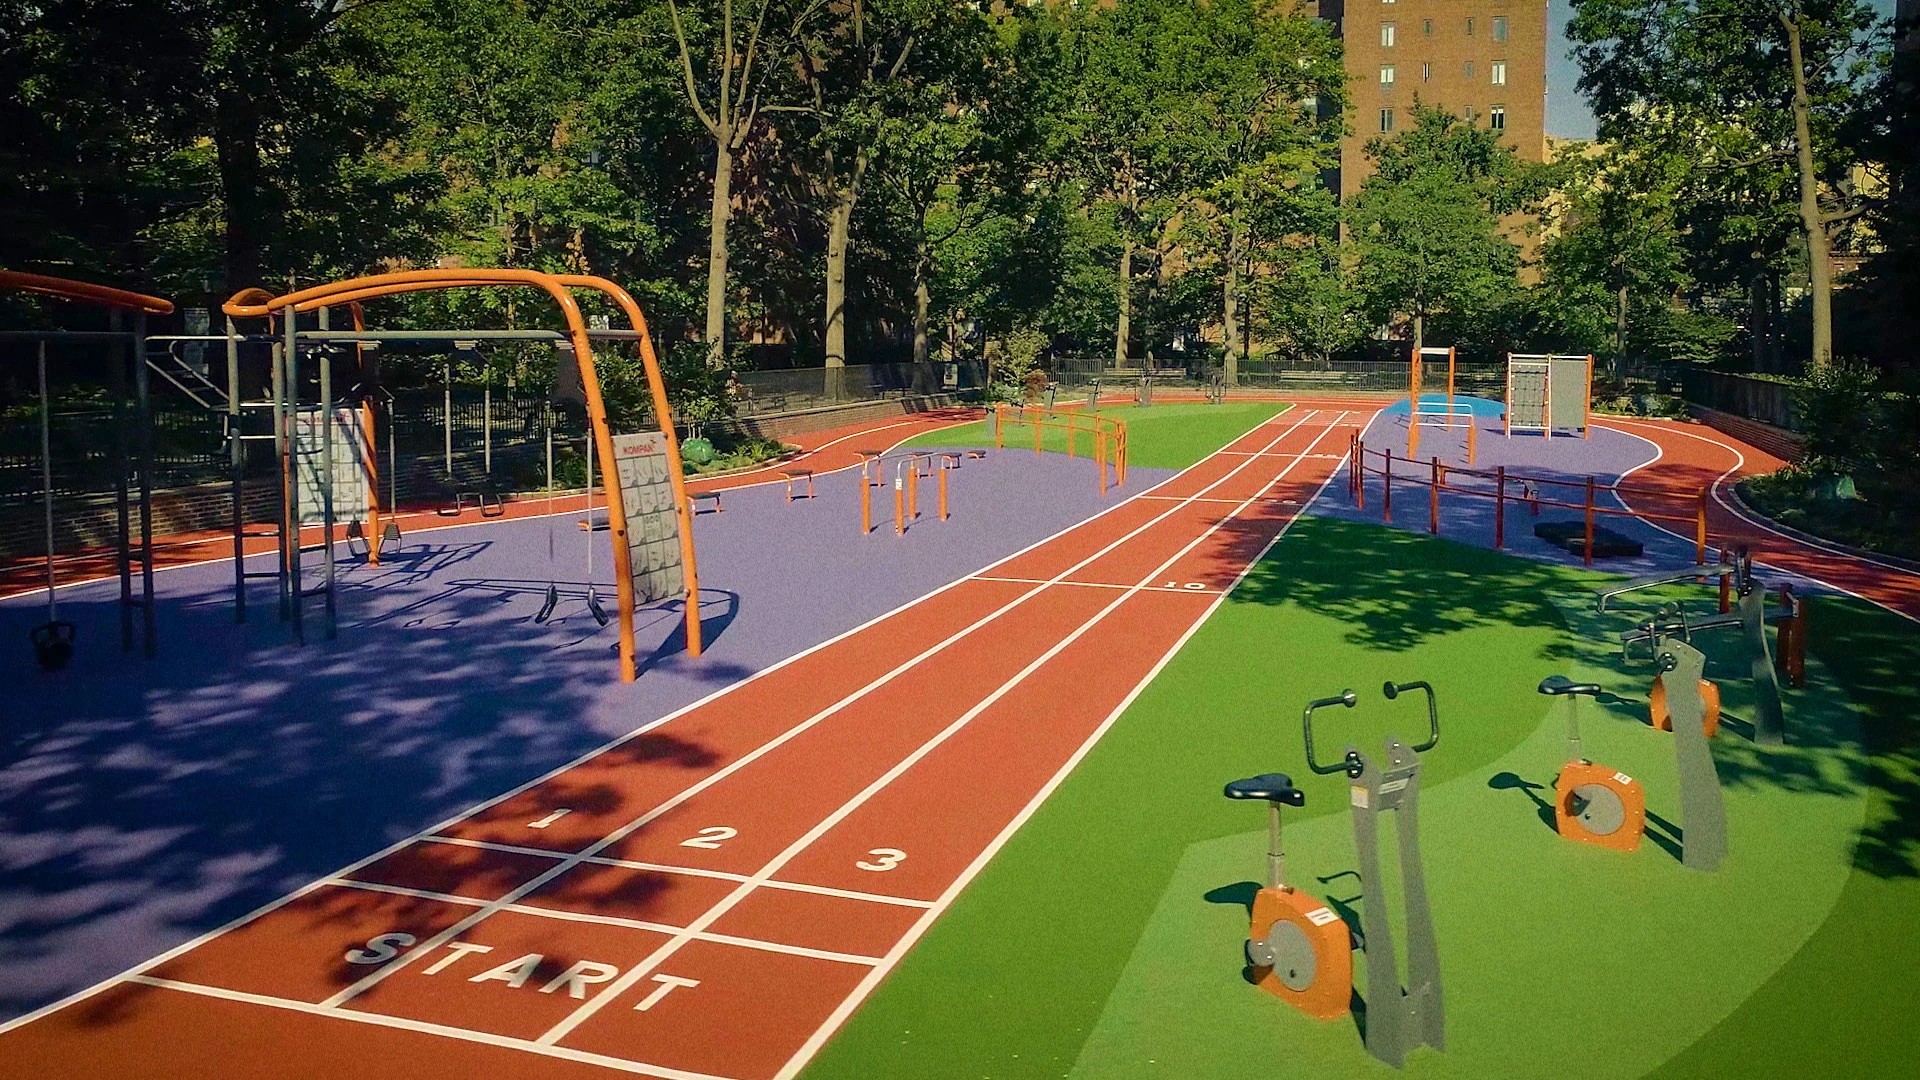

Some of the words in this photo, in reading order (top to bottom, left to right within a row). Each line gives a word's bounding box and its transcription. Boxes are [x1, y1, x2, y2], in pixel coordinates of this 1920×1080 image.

[1164, 581, 1206, 590] 10
[526, 807, 573, 829] 1
[679, 826, 738, 850] 2
[855, 848, 907, 872] 3
[344, 932, 701, 1012] START
